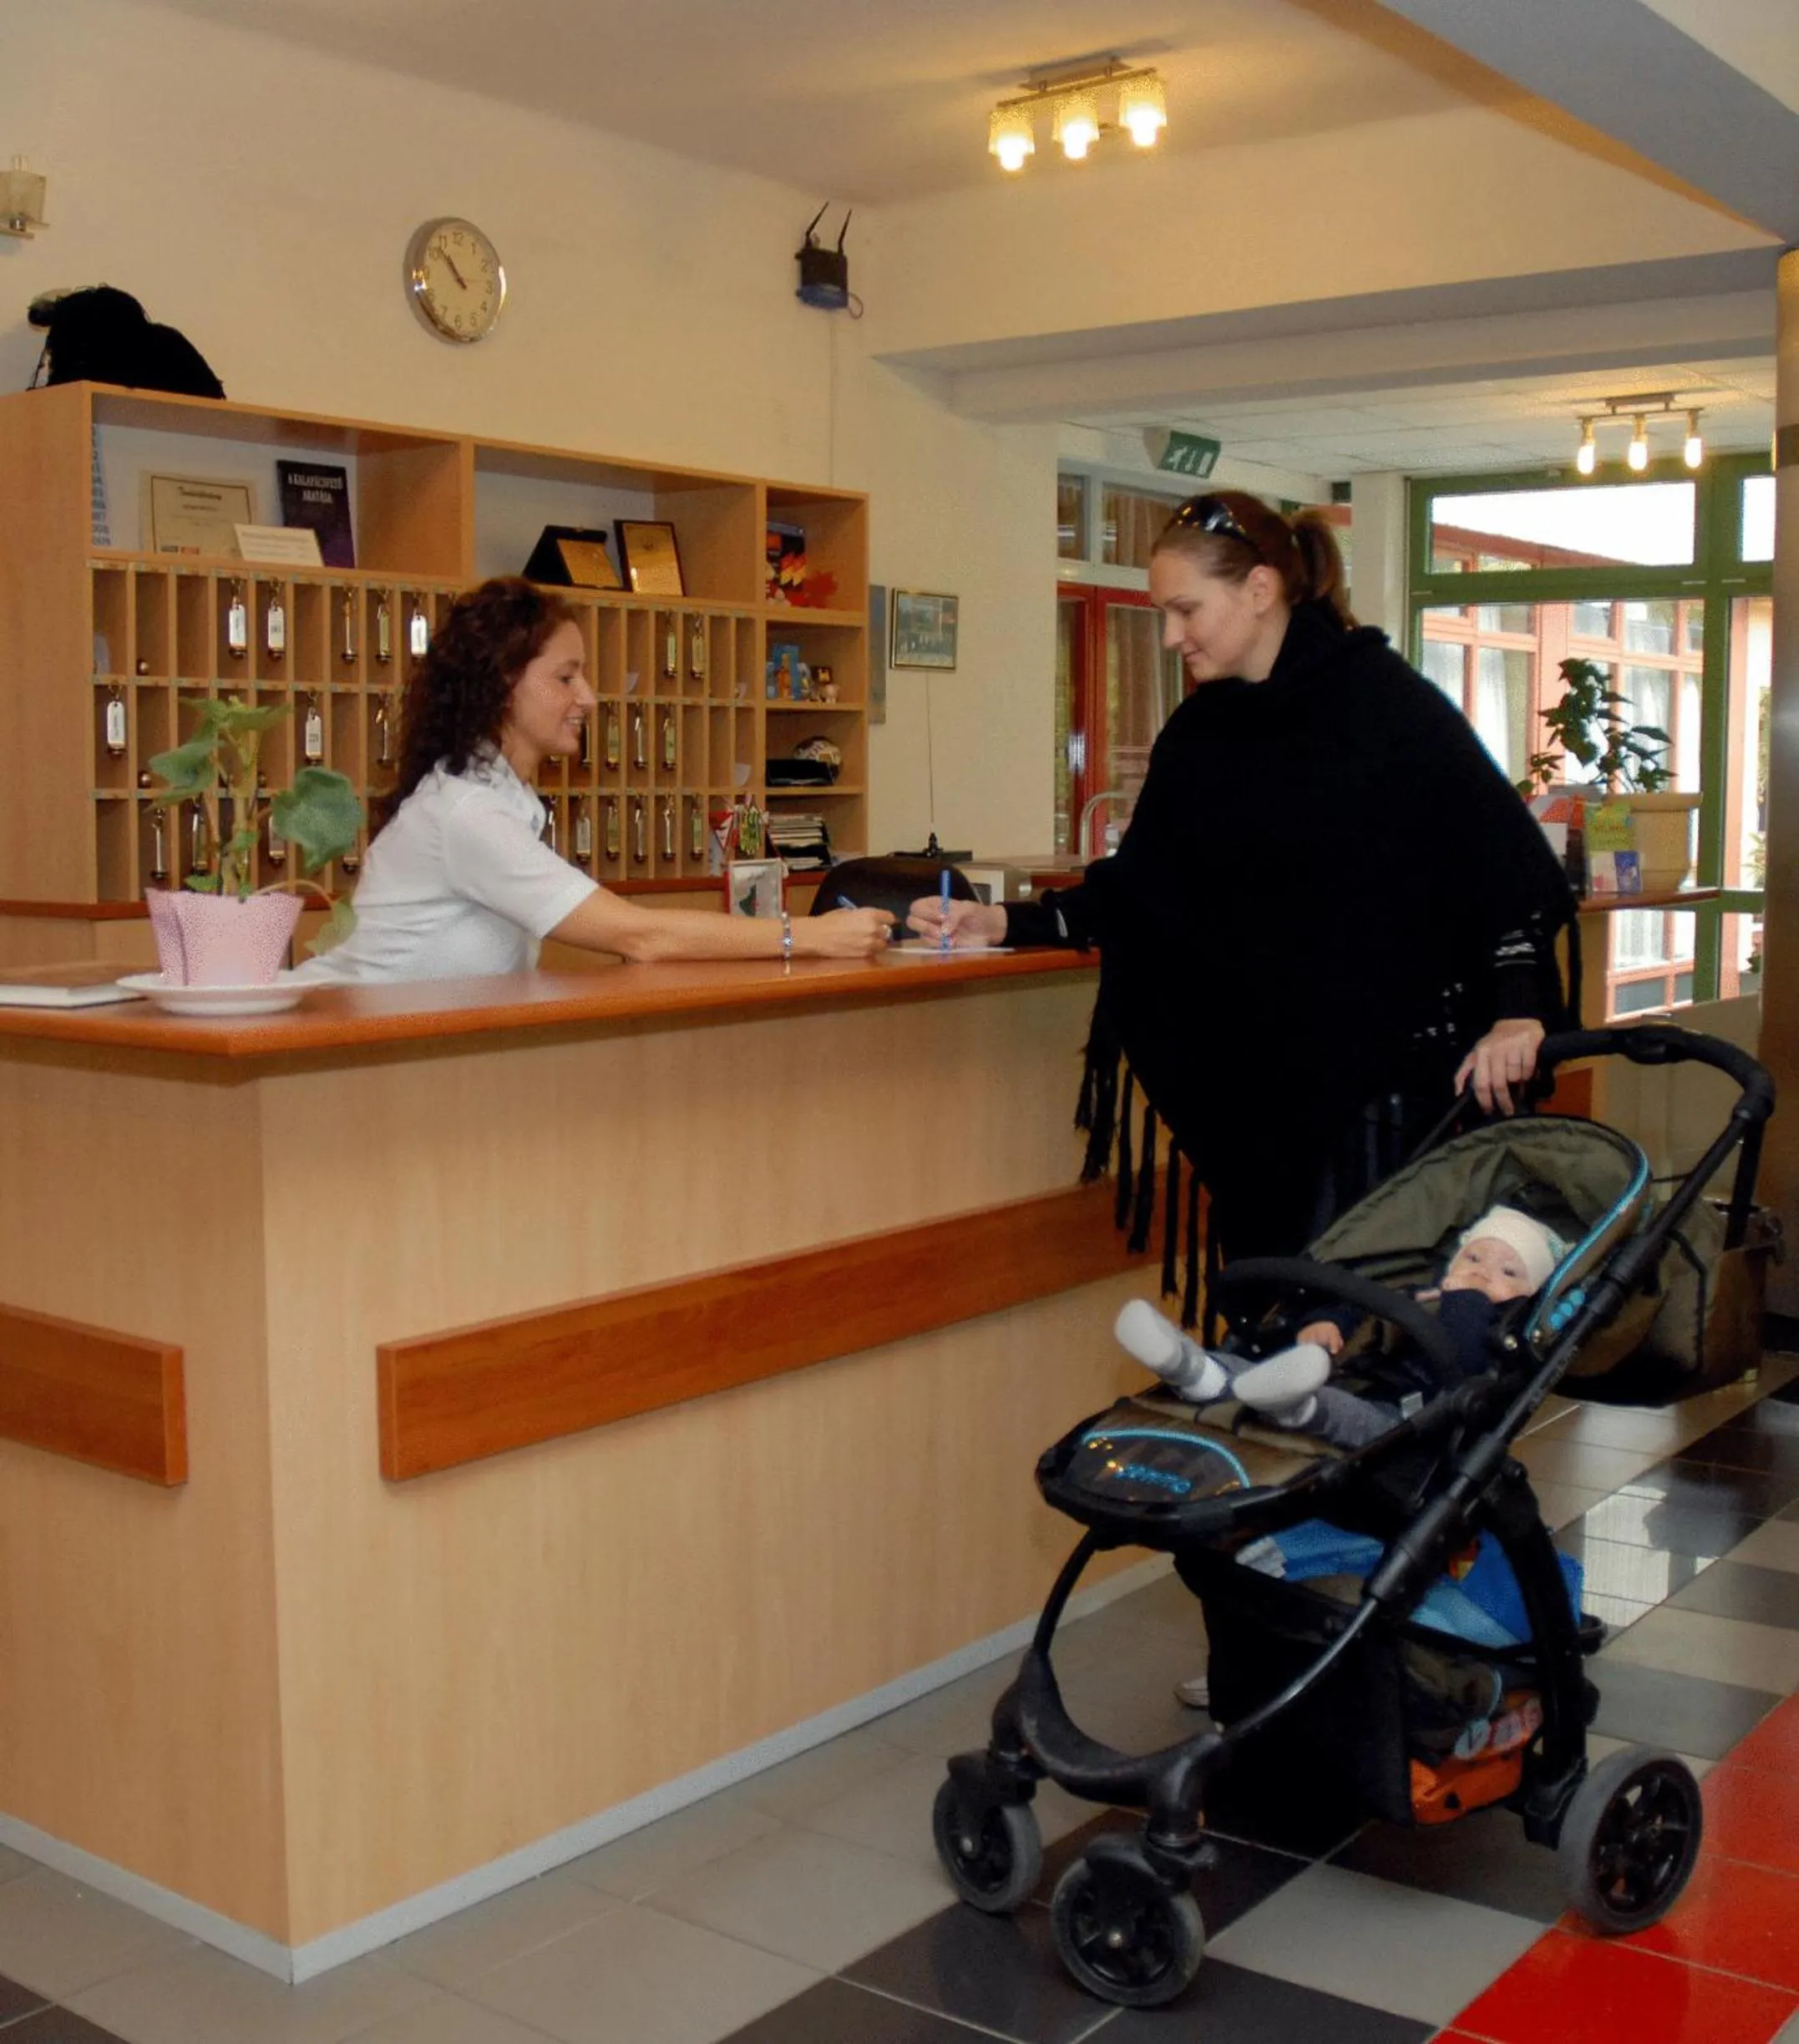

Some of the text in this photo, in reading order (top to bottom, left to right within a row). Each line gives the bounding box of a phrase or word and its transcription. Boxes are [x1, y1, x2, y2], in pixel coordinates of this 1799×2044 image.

[454, 231, 464, 246] 12
[428, 245, 439, 261] 10
[470, 243, 476, 255] 1
[481, 260, 488, 272] 2
[485, 281, 493, 295] 3
[440, 305, 448, 316] 7
[481, 301, 487, 312] 4
[454, 315, 462, 328] 6
[471, 313, 479, 326] 5
